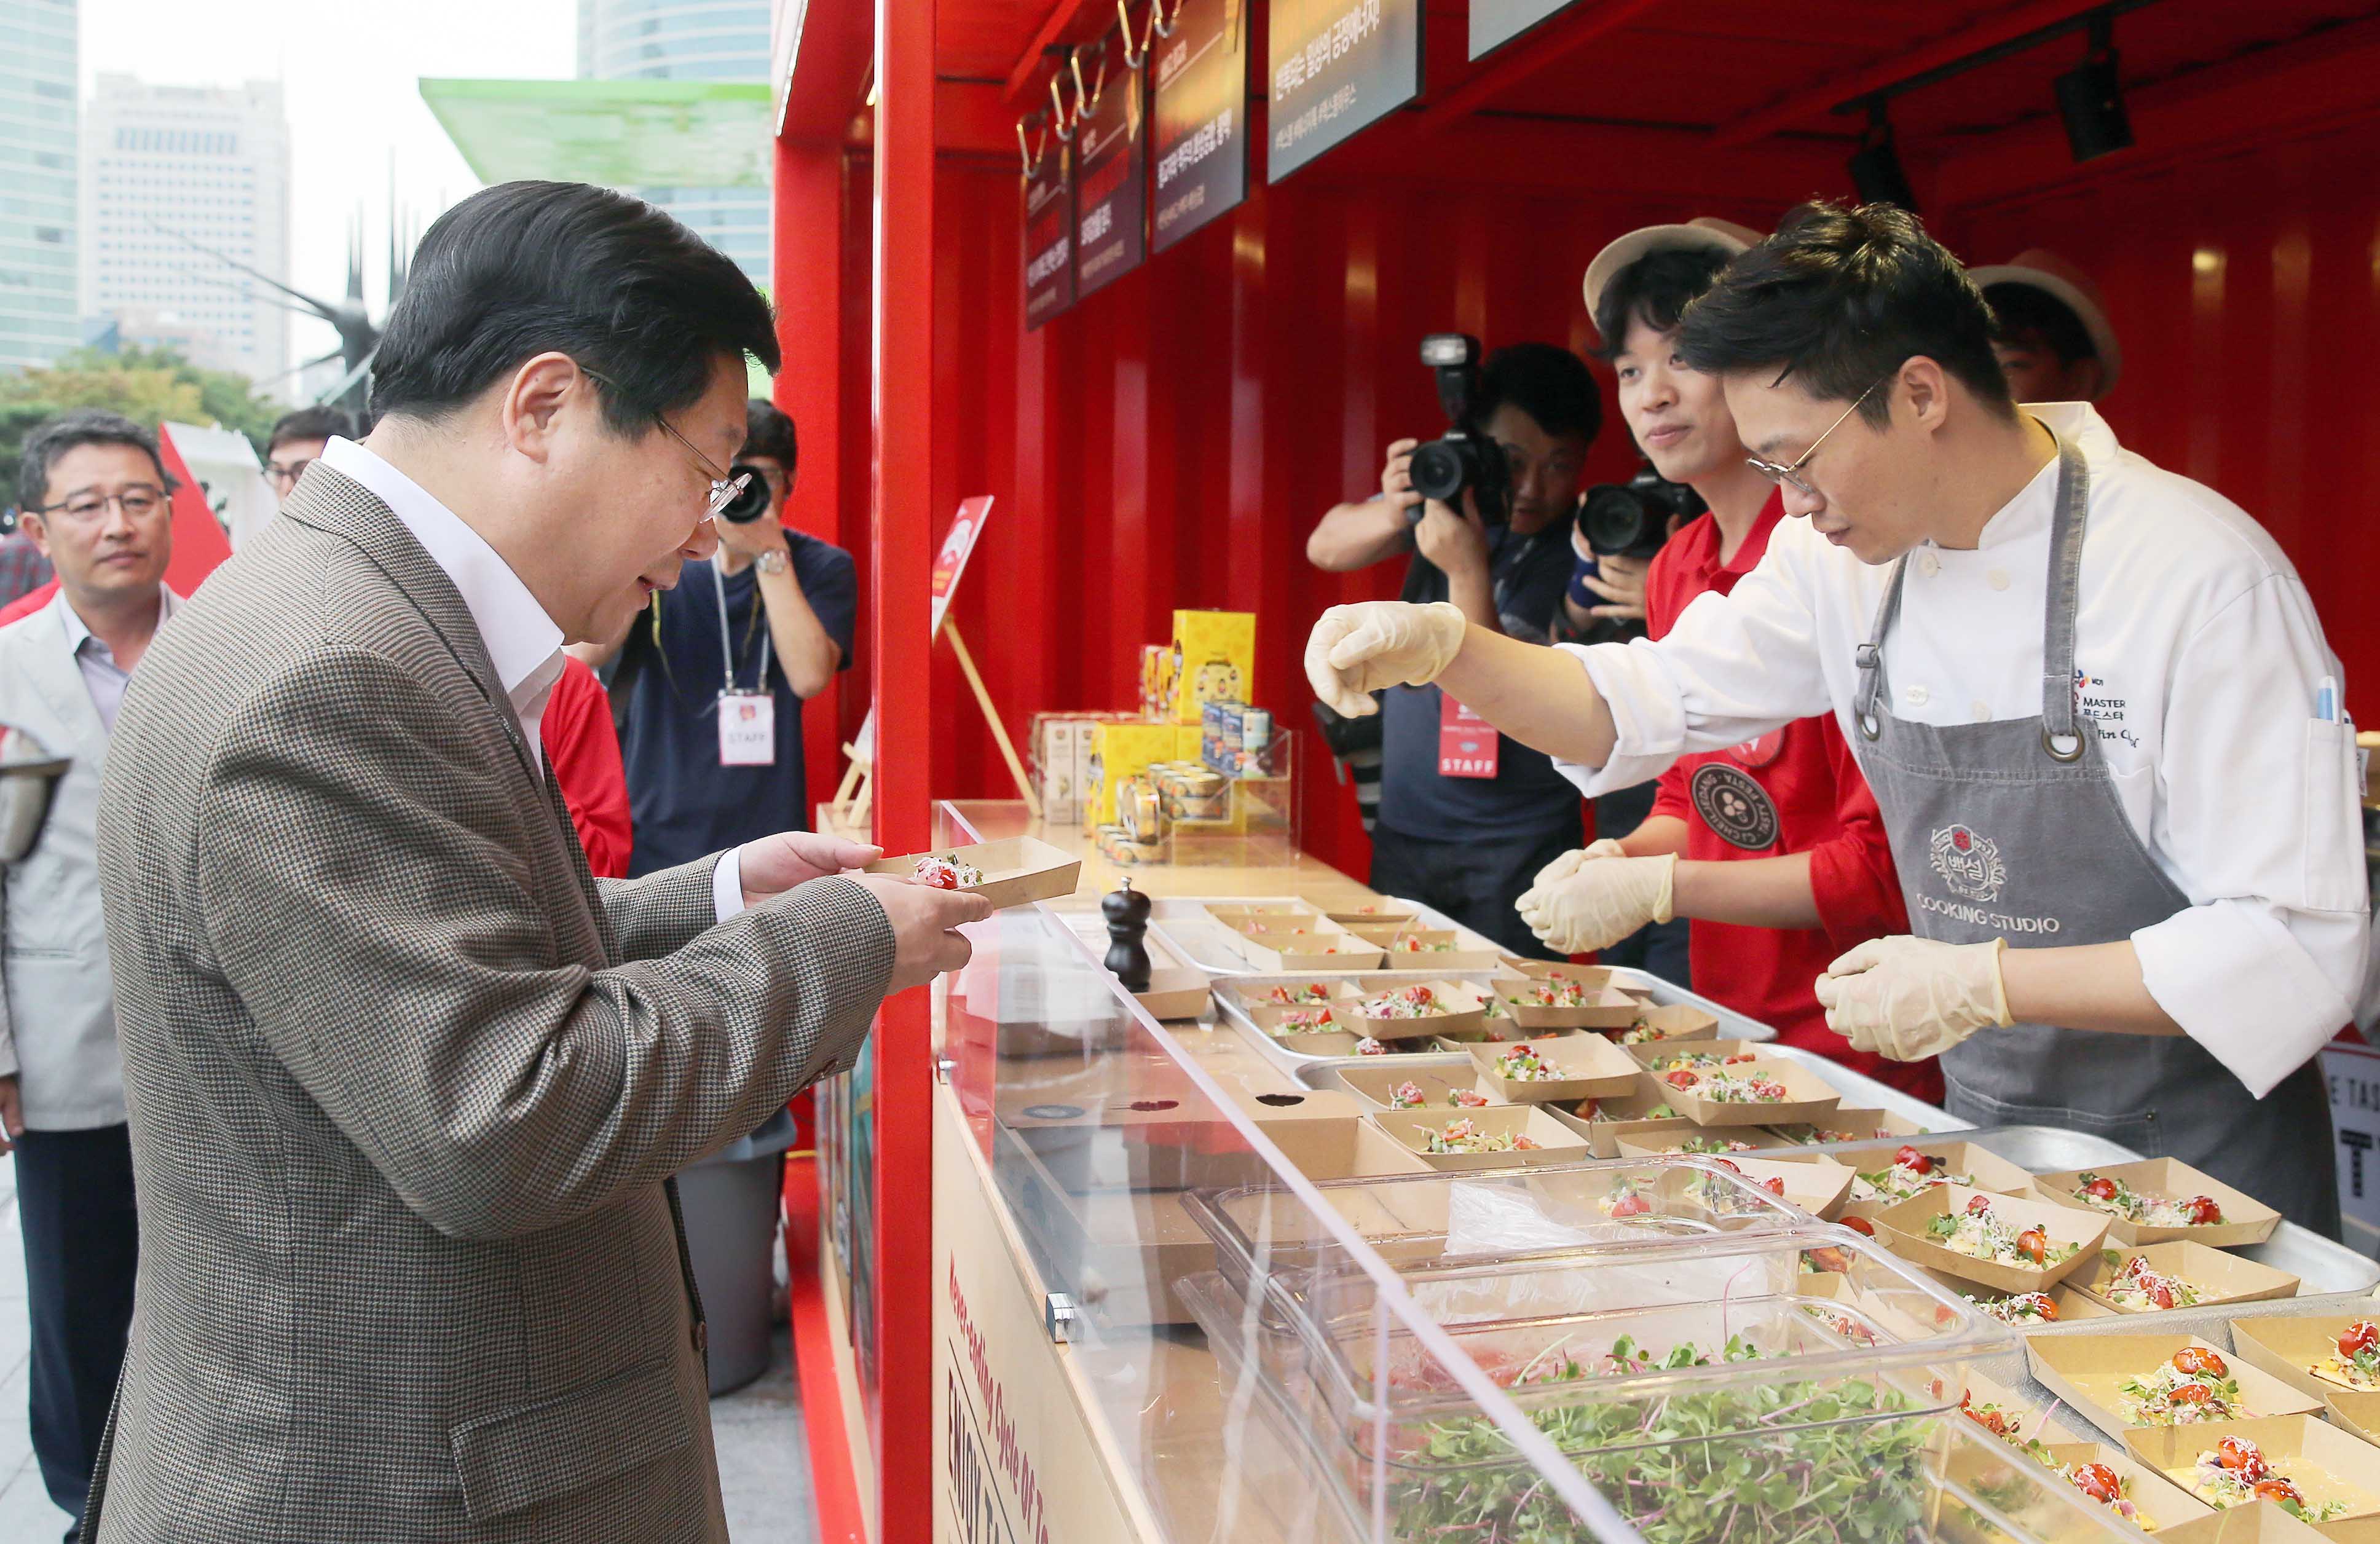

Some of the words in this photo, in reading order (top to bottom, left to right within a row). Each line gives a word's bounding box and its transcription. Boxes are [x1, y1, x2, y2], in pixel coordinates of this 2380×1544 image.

[2083, 697, 2126, 707] MASTER
[1441, 758, 1494, 773] STAFF
[1947, 854, 1985, 881] 백설
[1917, 892, 1988, 925] COOKING
[1989, 912, 2060, 934] STUDIO
[949, 1248, 993, 1436] Never-ending
[996, 1381, 1019, 1495] Cycle
[949, 1366, 982, 1544] ENJOY
